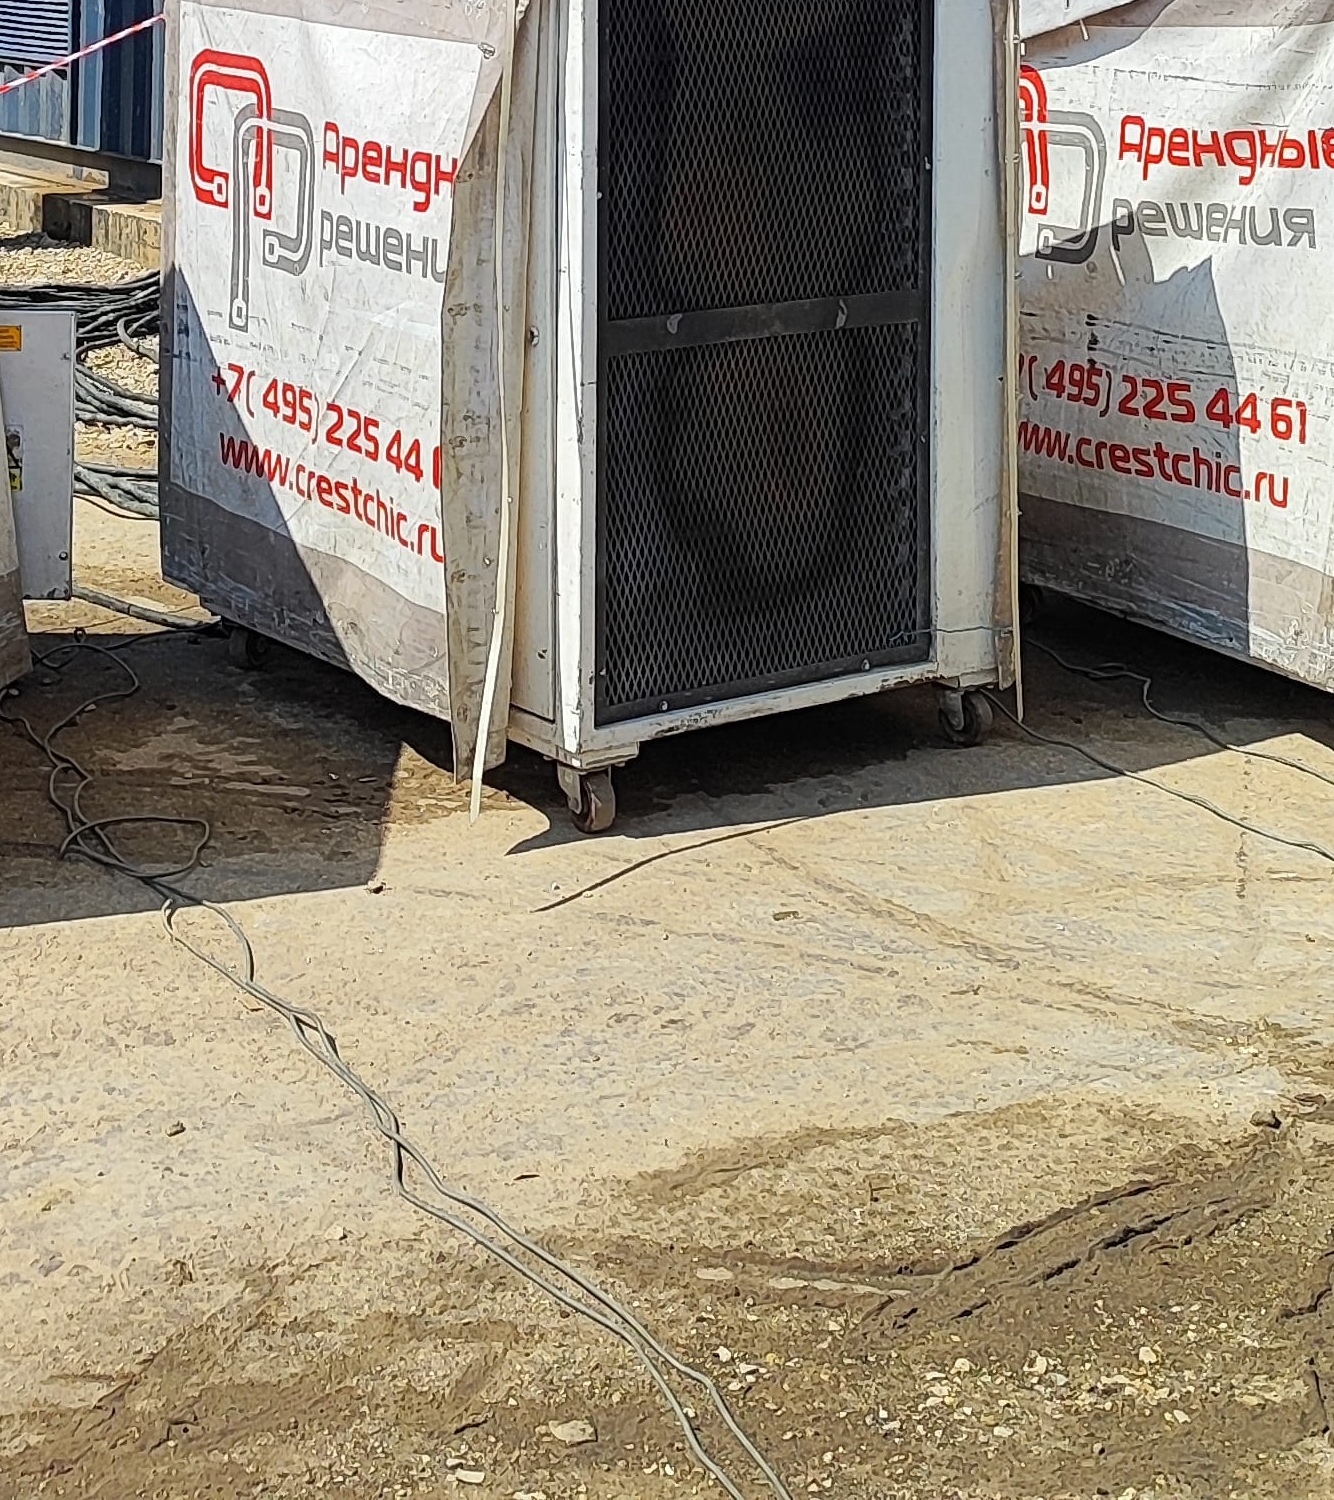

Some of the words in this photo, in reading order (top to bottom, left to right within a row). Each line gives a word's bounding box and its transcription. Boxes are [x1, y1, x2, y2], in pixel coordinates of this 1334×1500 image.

[322, 120, 458, 213] Арендн
[1111, 197, 1317, 249] решения
[325, 402, 380, 463] 225
[385, 429, 424, 483] 44
[1118, 373, 1197, 424] 225
[1205, 387, 1262, 435] 44
[1270, 396, 1307, 445] 61
[1017, 420, 1289, 509] ww.crestchic.ru
